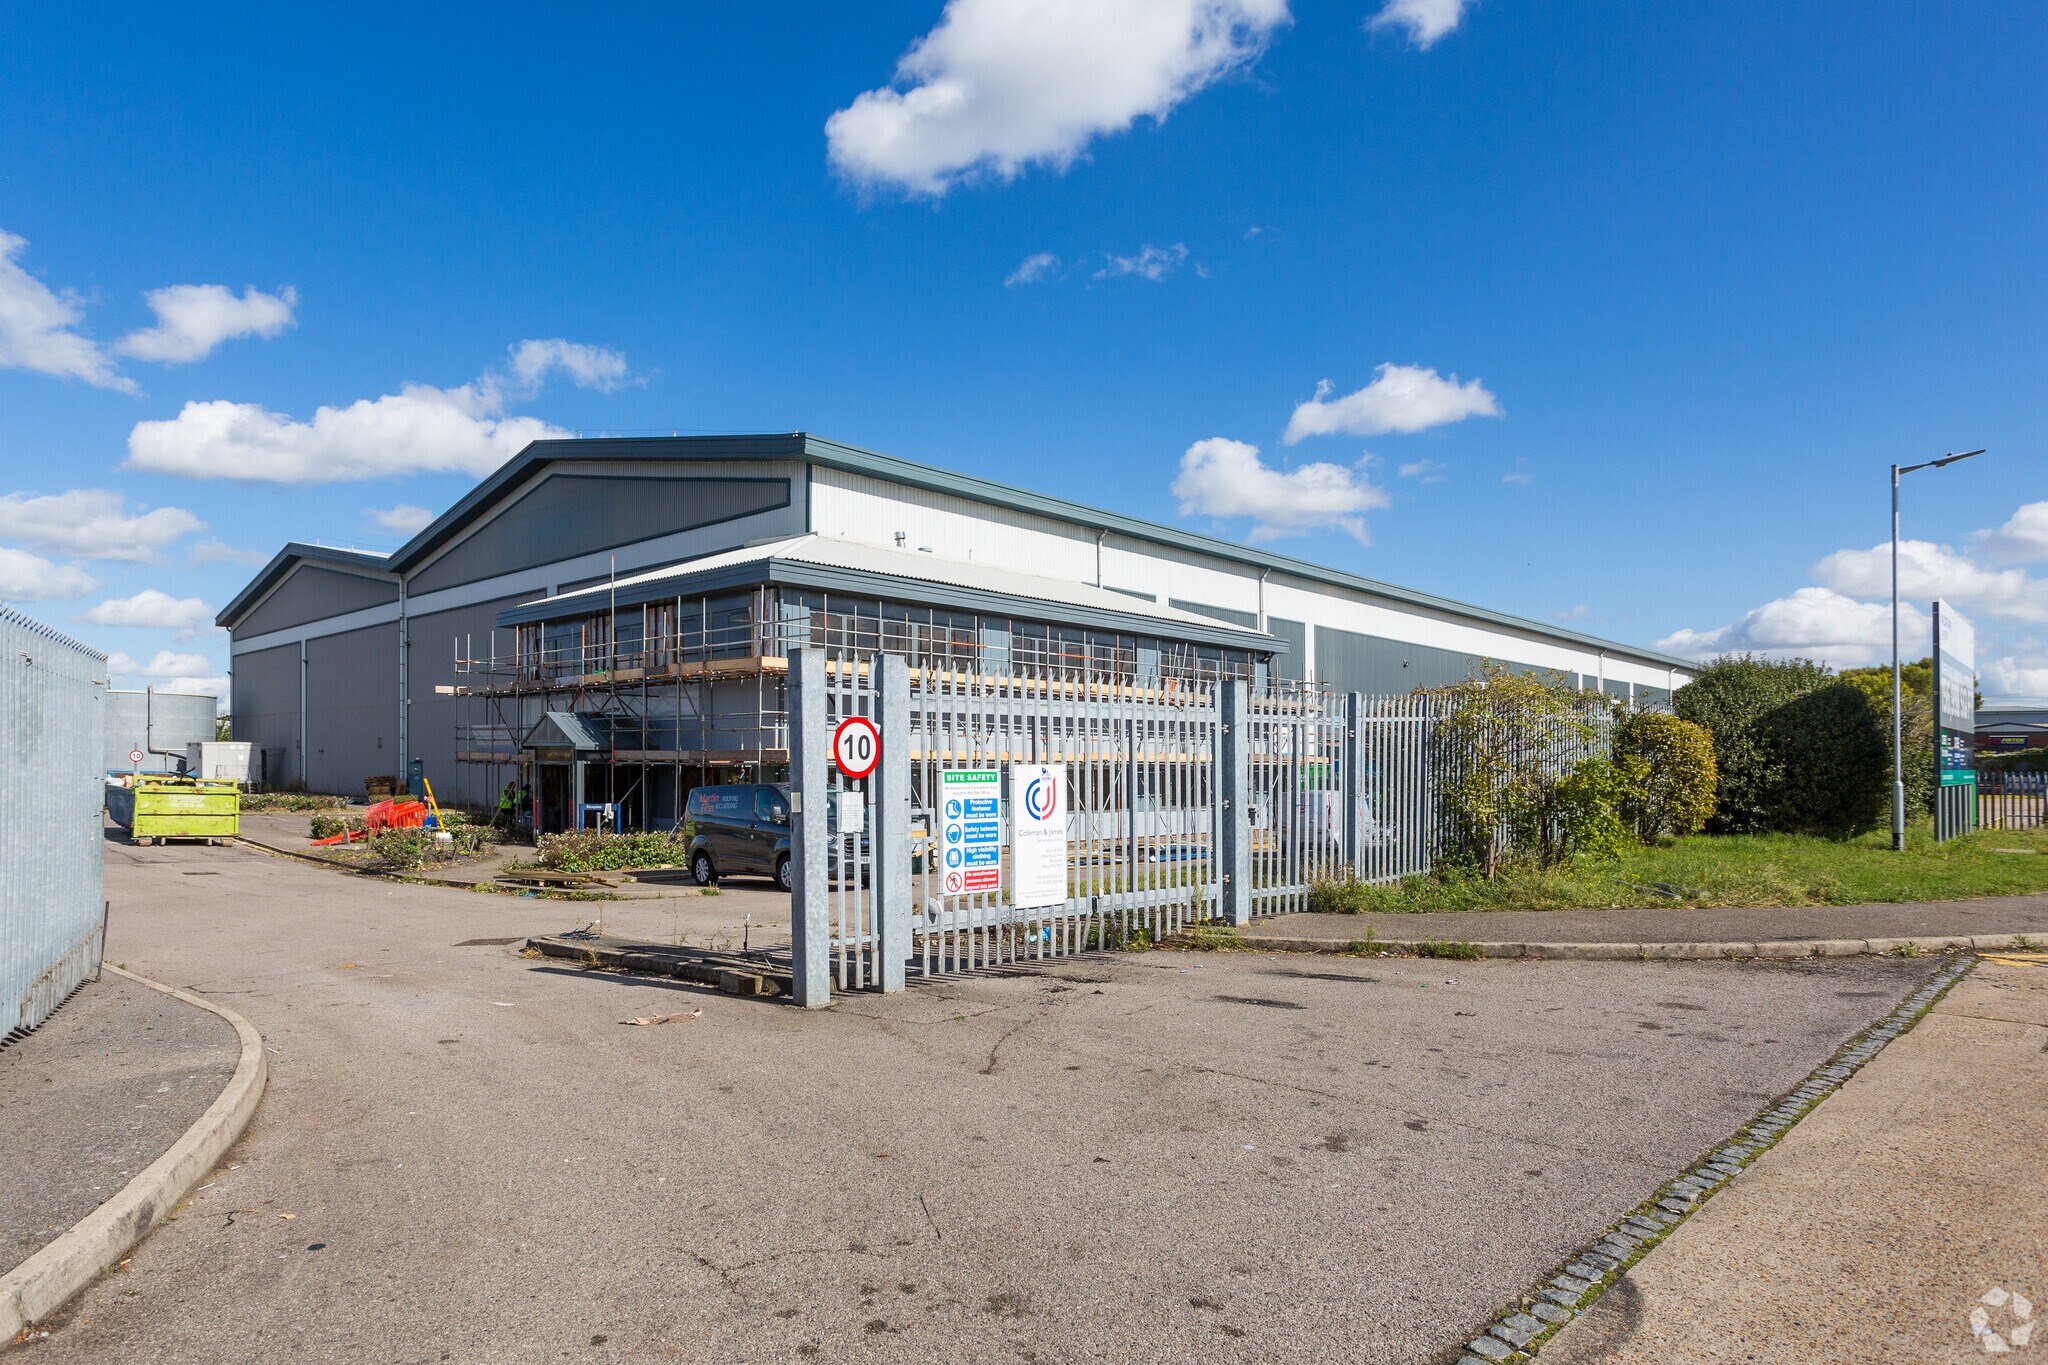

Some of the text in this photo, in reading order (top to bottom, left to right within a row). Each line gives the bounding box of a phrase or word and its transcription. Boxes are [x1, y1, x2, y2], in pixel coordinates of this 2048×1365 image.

[844, 734, 871, 760] 10
[1018, 828, 1063, 837] Coleman & James
